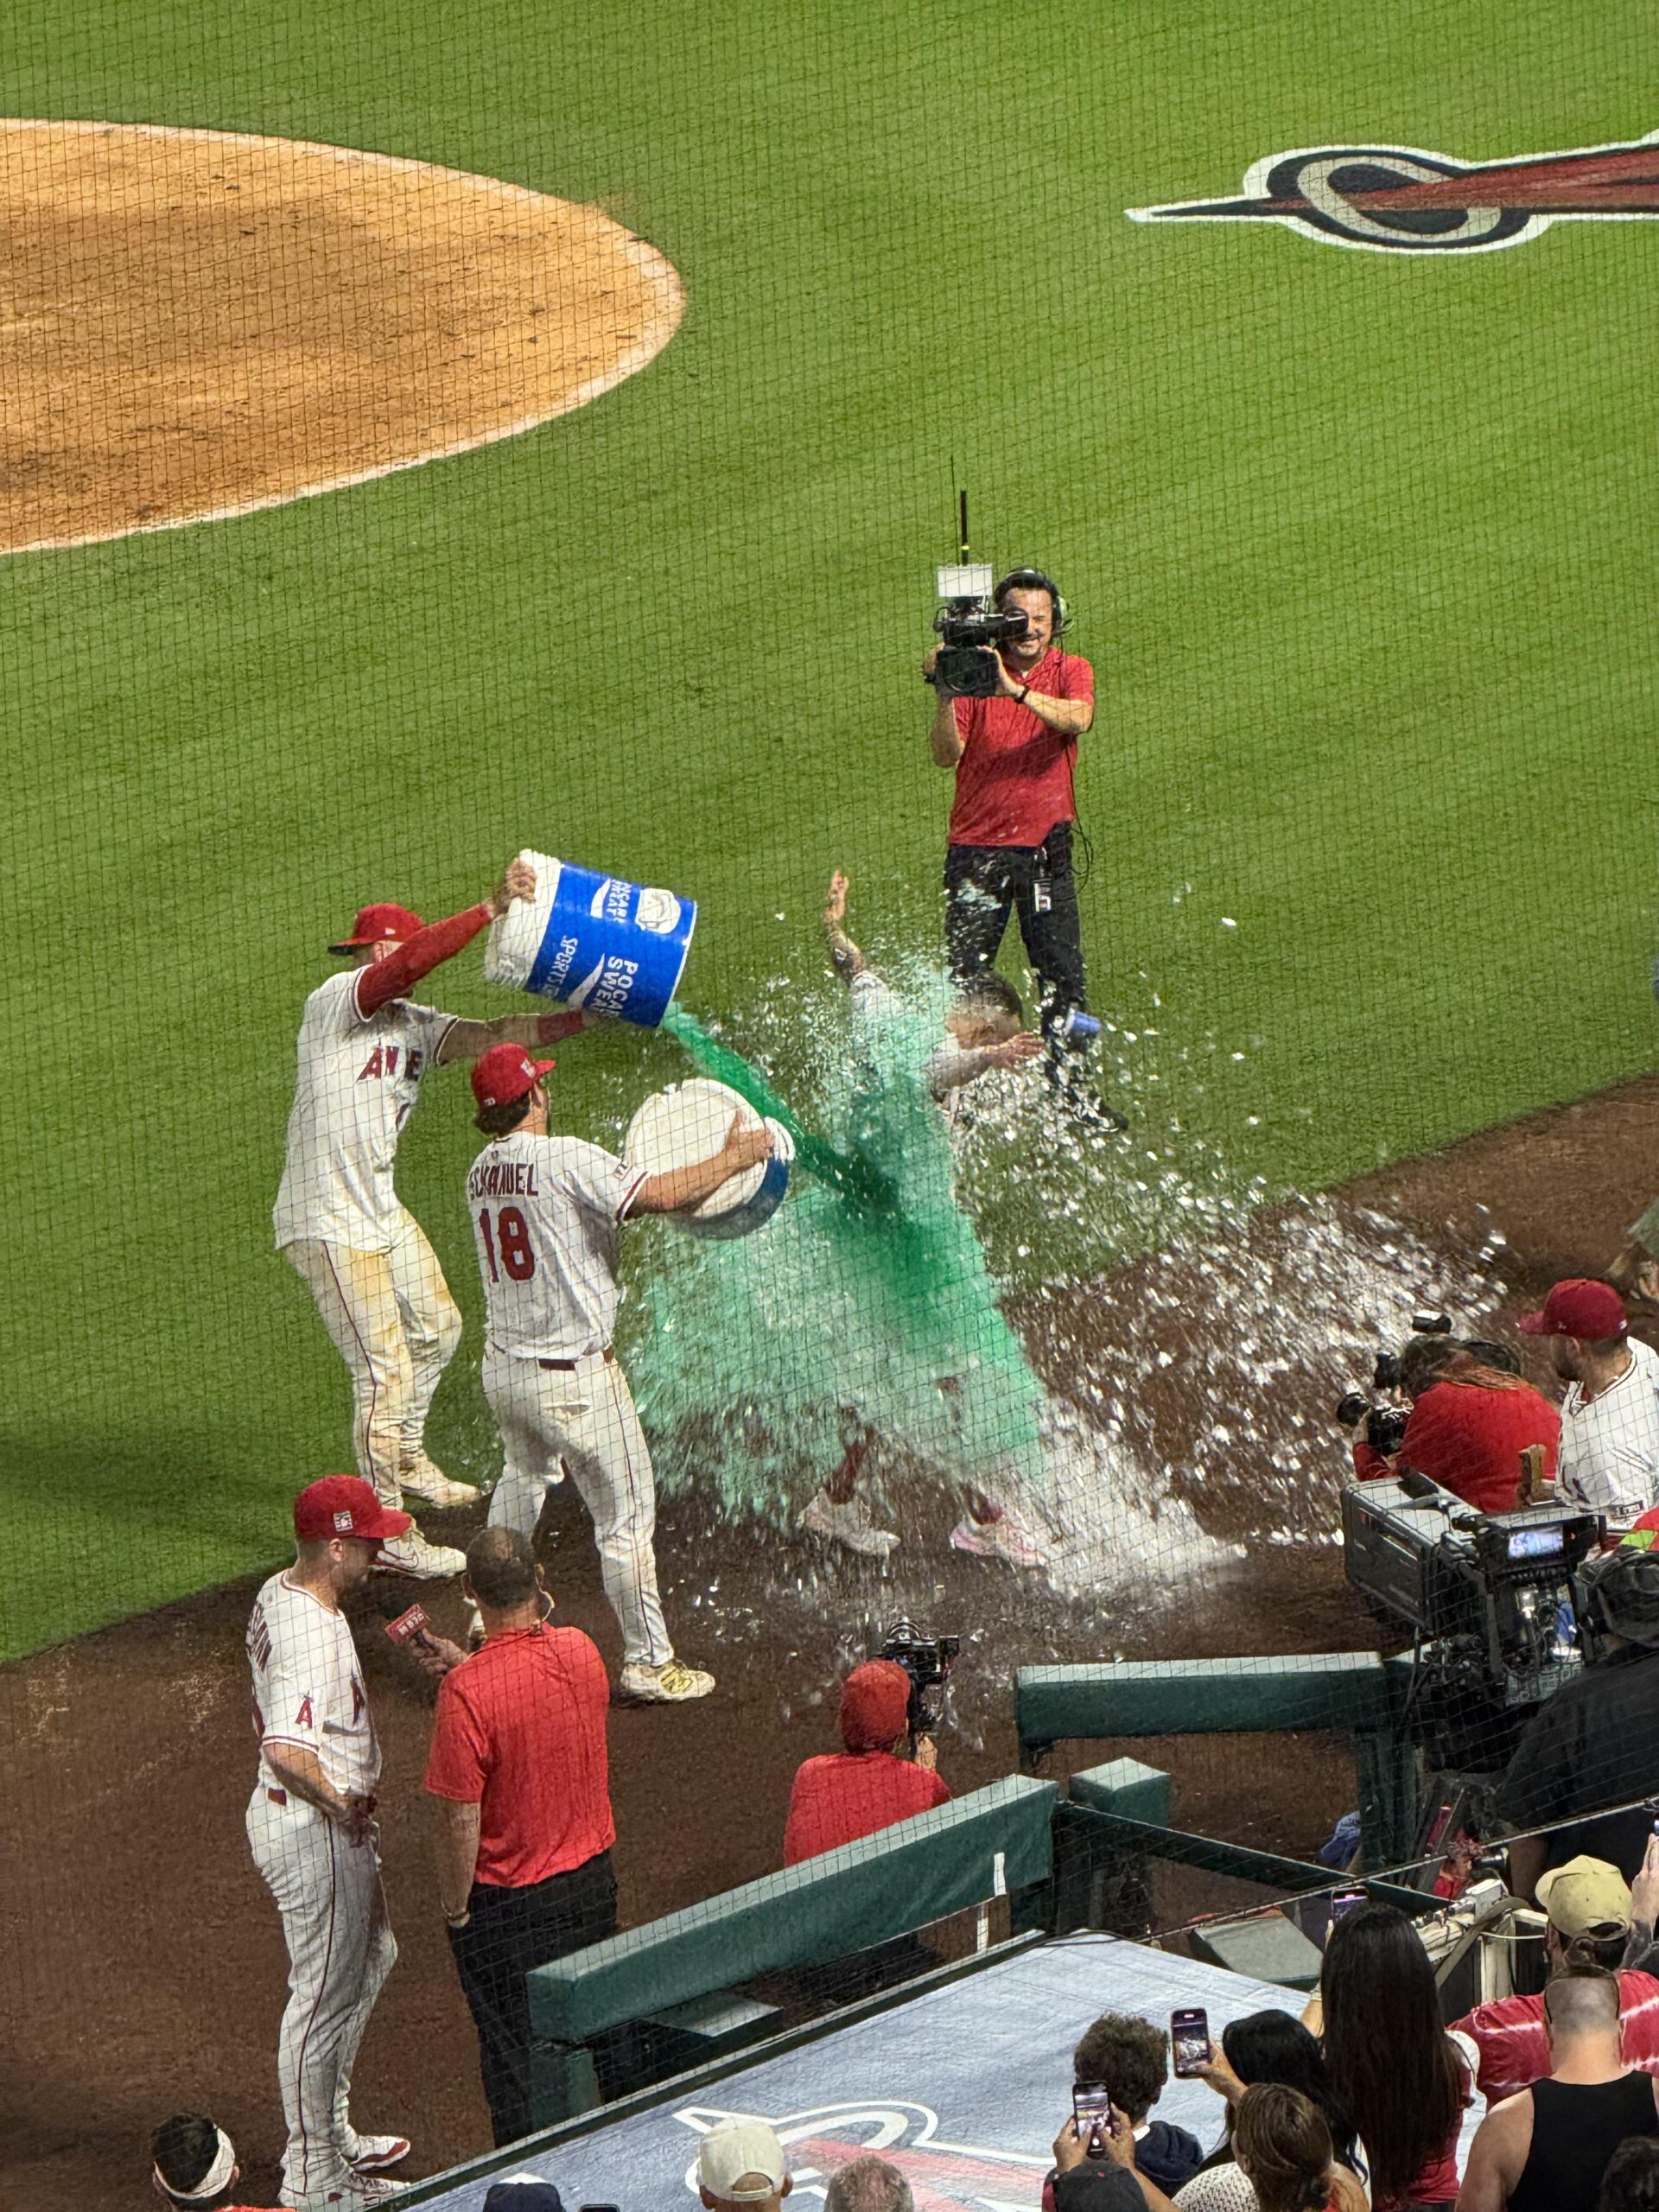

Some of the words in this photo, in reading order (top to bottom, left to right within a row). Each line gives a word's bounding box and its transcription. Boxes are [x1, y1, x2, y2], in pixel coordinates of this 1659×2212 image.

[590, 956, 623, 1012] SWEA
[604, 960, 639, 1019] POCAR
[479, 1205, 536, 1283] 18
